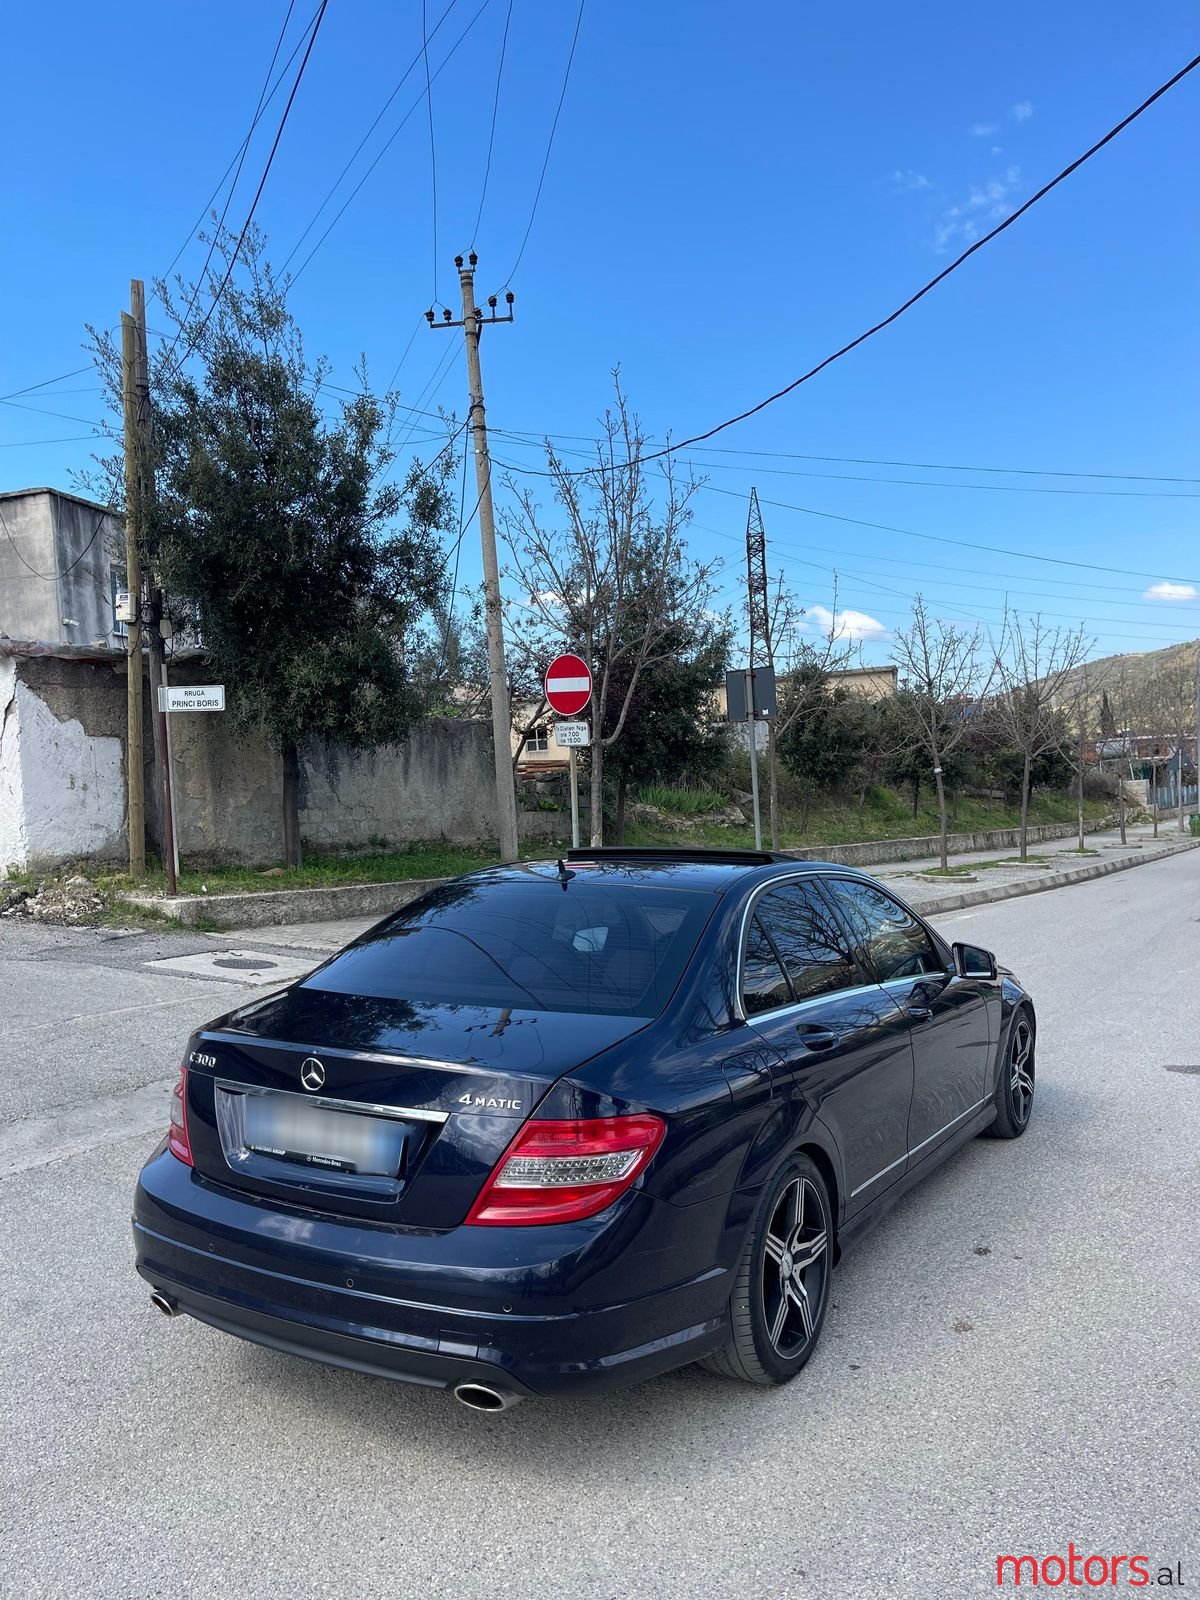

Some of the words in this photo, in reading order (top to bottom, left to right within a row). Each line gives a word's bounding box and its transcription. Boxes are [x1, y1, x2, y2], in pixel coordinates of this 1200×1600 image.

[171, 700, 196, 708] PRINCI
[196, 699, 219, 707] BORIS
[189, 1051, 217, 1068] C300
[312, 1156, 342, 1167] Mercedes-Benz
